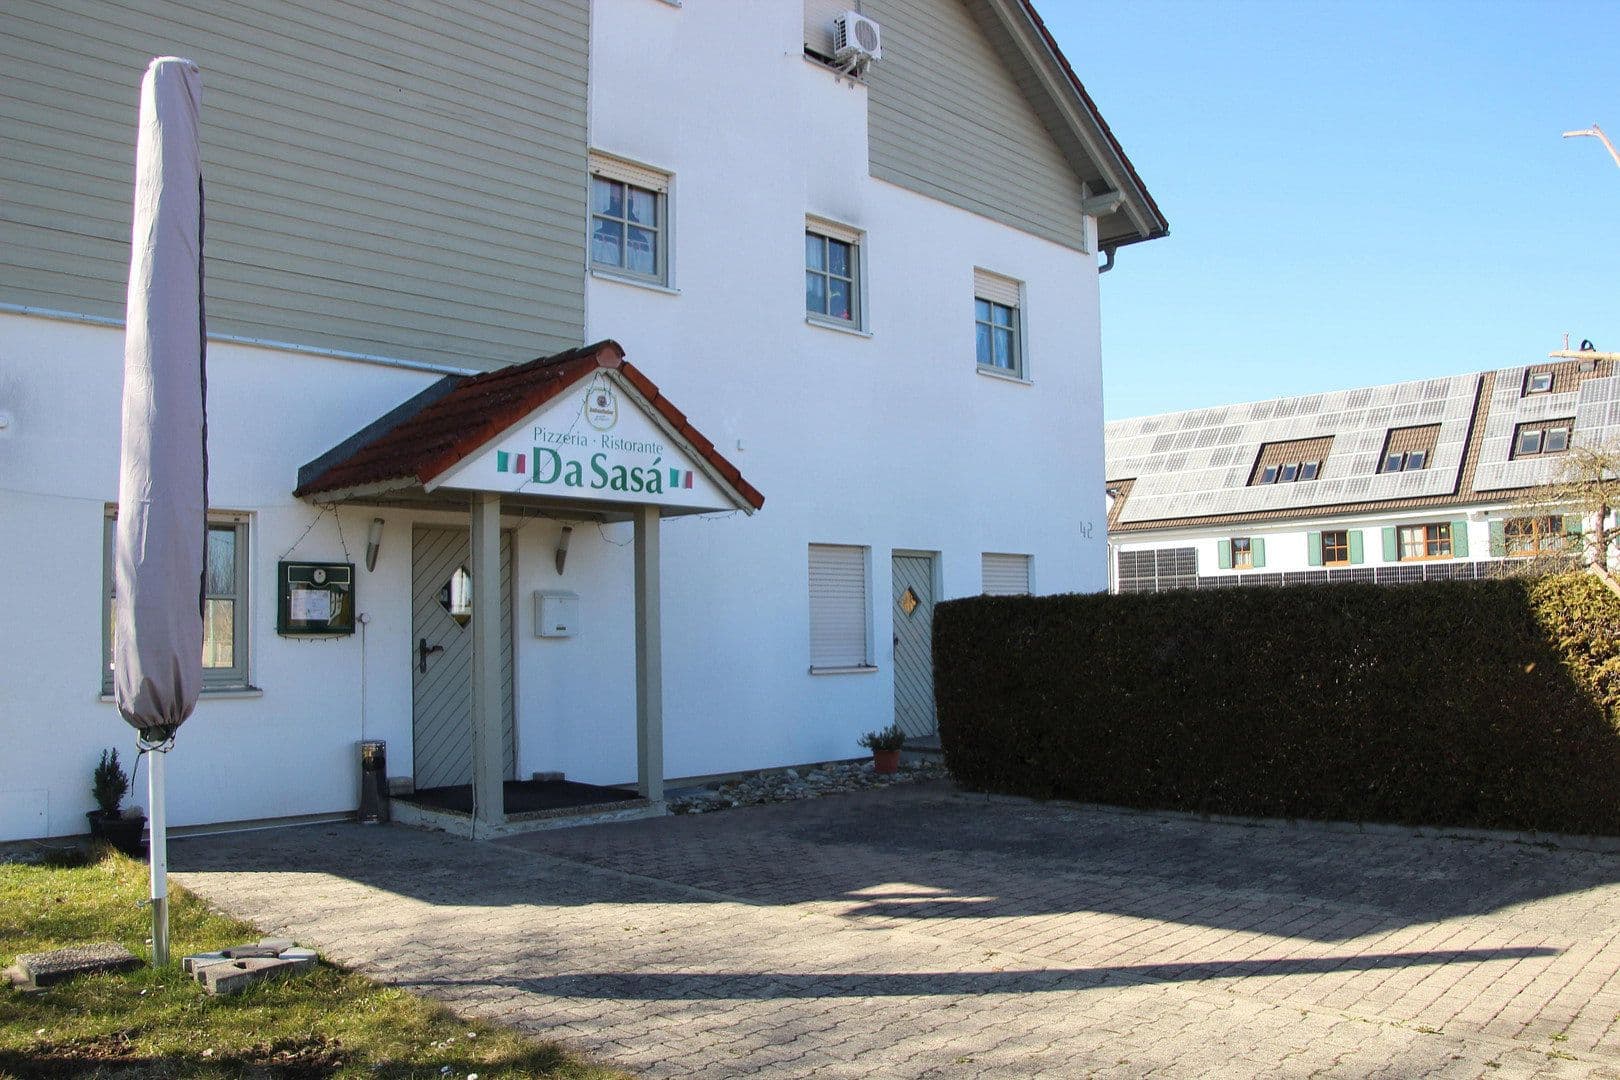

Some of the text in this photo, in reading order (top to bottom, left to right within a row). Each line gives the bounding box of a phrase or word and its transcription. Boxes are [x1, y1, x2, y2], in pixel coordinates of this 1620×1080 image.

[533, 426, 664, 454] Pizzeria Ristorante
[532, 446, 663, 495] Da Sasá
[1080, 521, 1093, 539] 42
